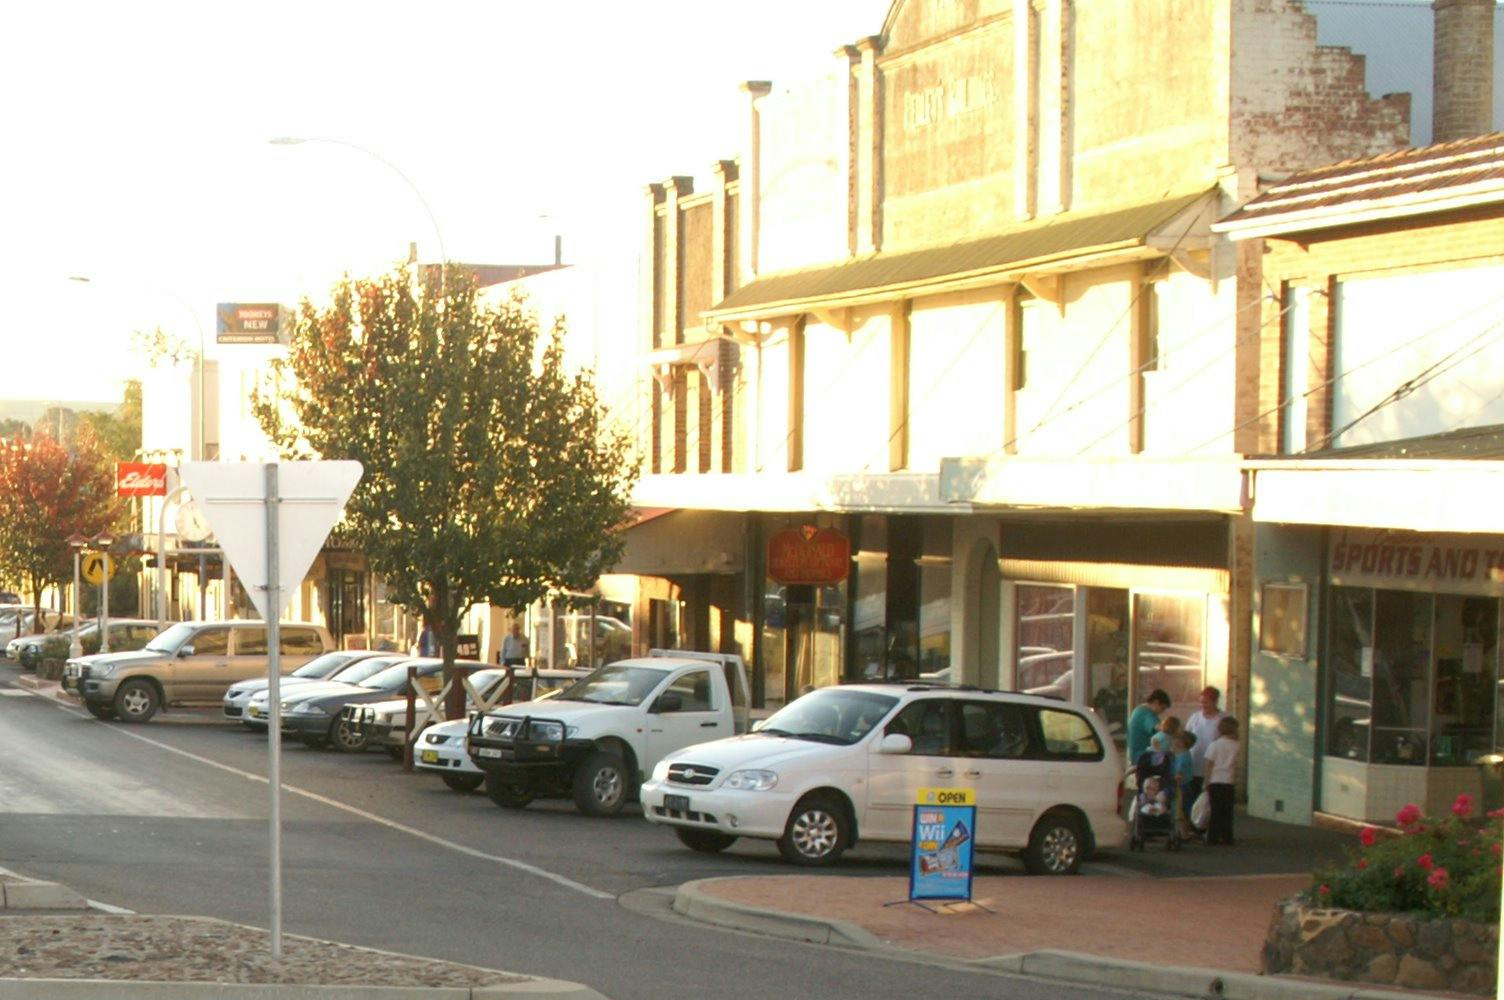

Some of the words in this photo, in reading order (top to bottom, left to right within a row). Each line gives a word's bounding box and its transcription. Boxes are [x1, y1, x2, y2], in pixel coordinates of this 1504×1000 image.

[244, 320, 268, 329] NEW
[119, 472, 164, 488] Elders
[1332, 543, 1424, 576] SPORTS
[1425, 547, 1479, 579] AND
[938, 792, 966, 803] OPEN
[919, 825, 945, 840] Wii
